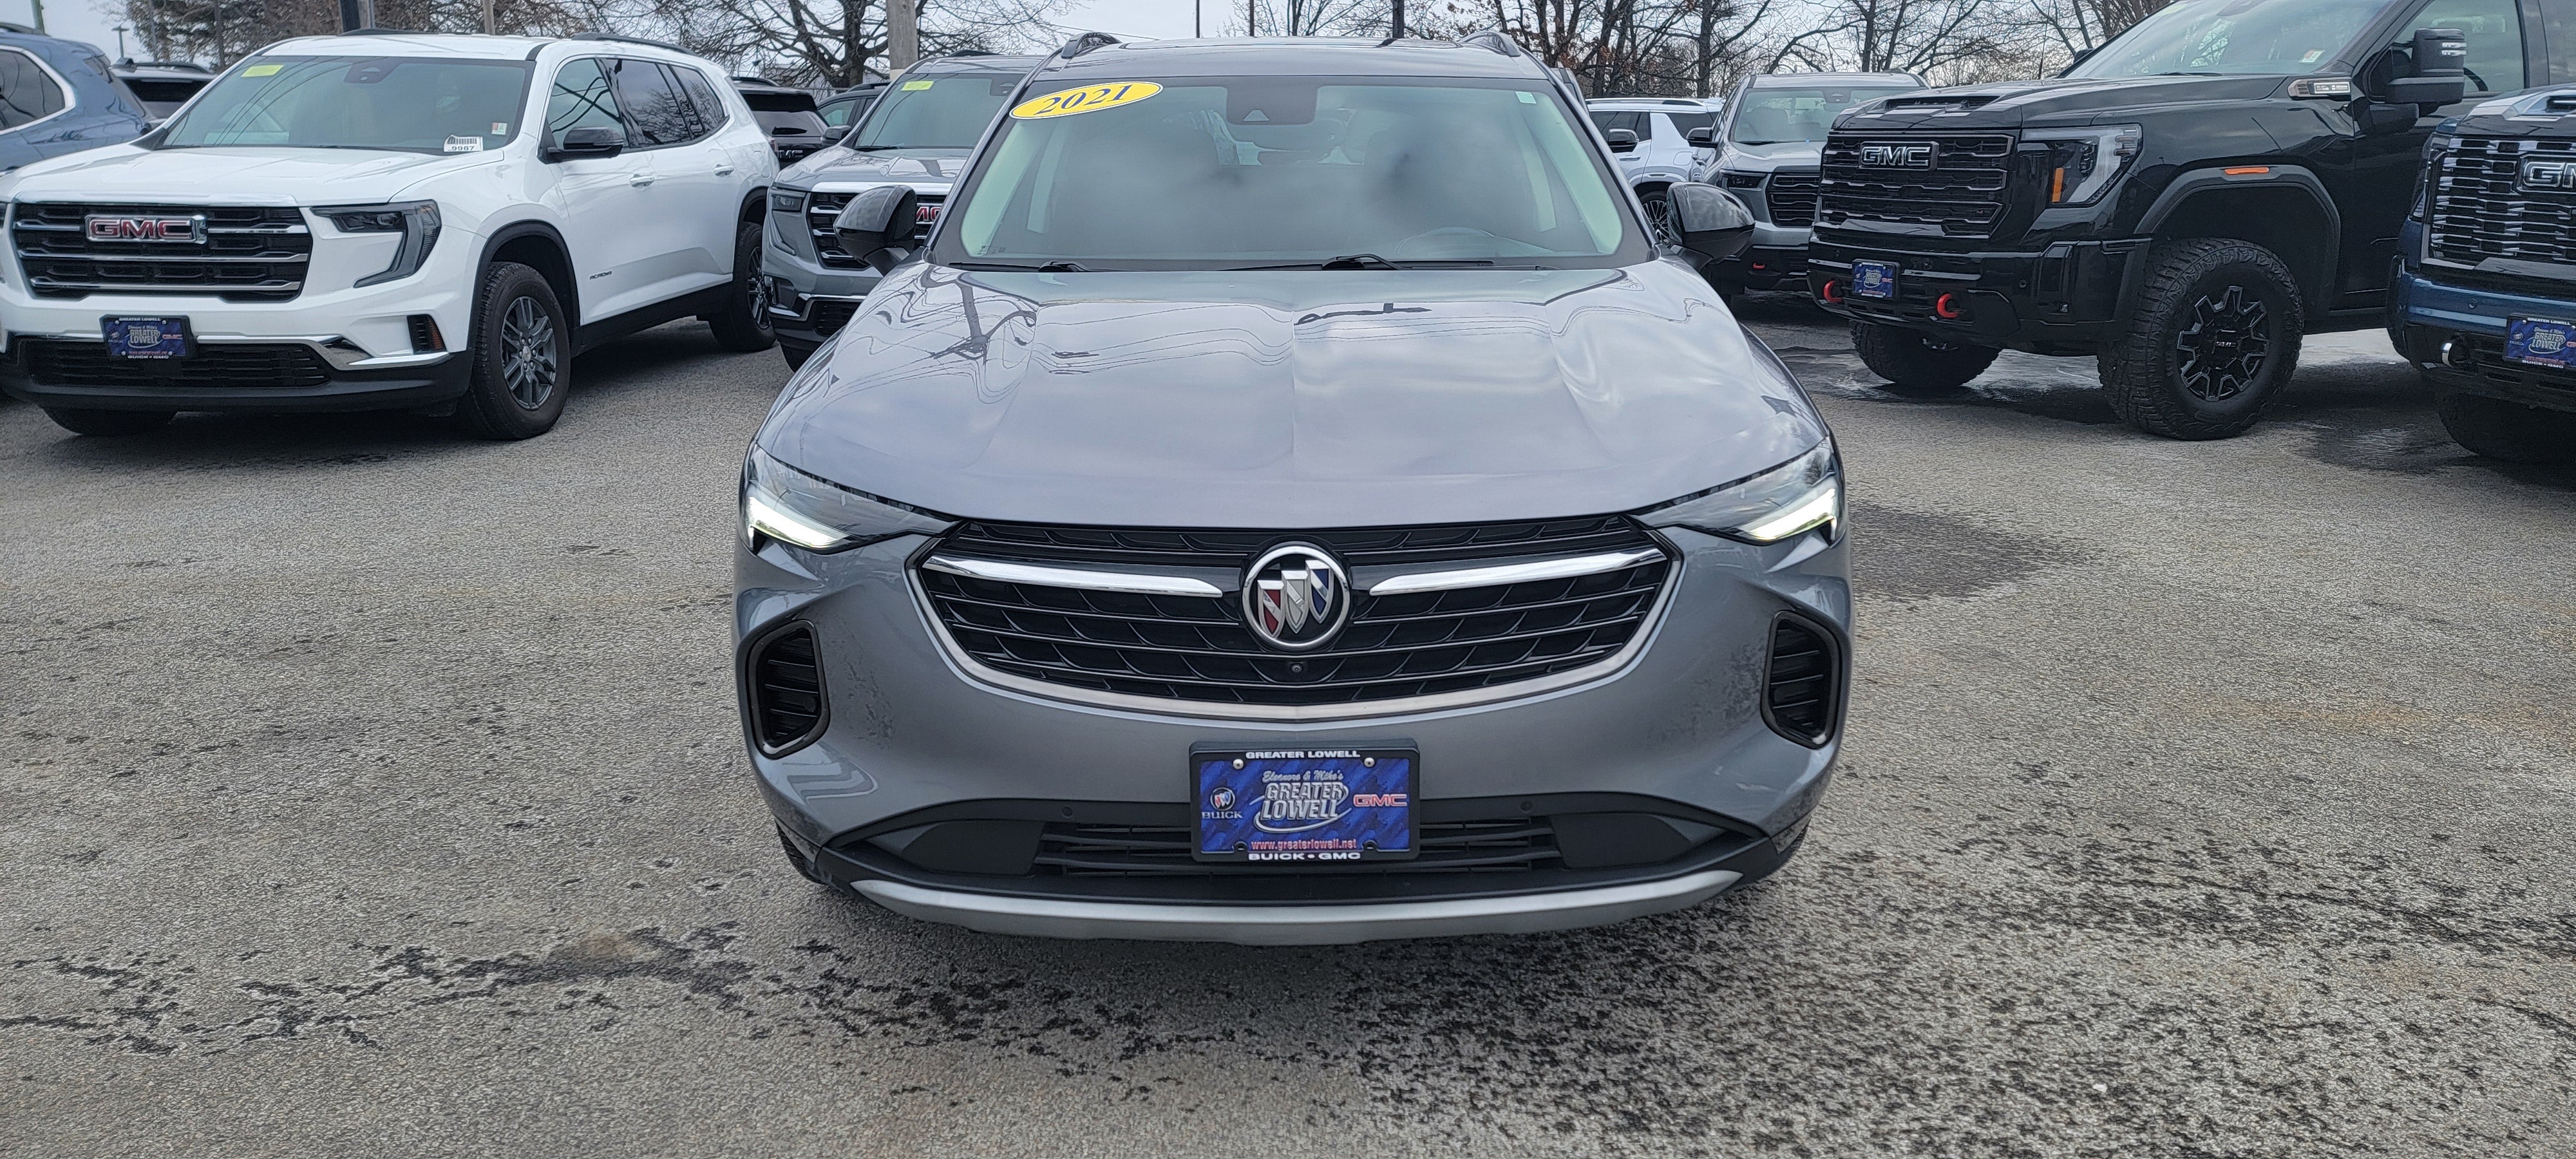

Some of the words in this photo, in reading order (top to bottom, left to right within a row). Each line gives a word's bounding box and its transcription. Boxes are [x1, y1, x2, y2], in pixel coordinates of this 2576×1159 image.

[1034, 84, 1133, 115] 2021
[1861, 146, 1931, 166] GMC
[89, 218, 192, 239] GMC
[2531, 339, 2562, 350] LOWELL
[1307, 750, 1361, 759] LOWELL
[1265, 782, 1343, 800] GREATER
[1353, 793, 1408, 807] GMC
[1260, 799, 1339, 820] LOWELL
[1251, 838, 1357, 851] www.greaterlowell.net
[1248, 853, 1305, 861] BUICK
[1318, 852, 1361, 860] GMC
